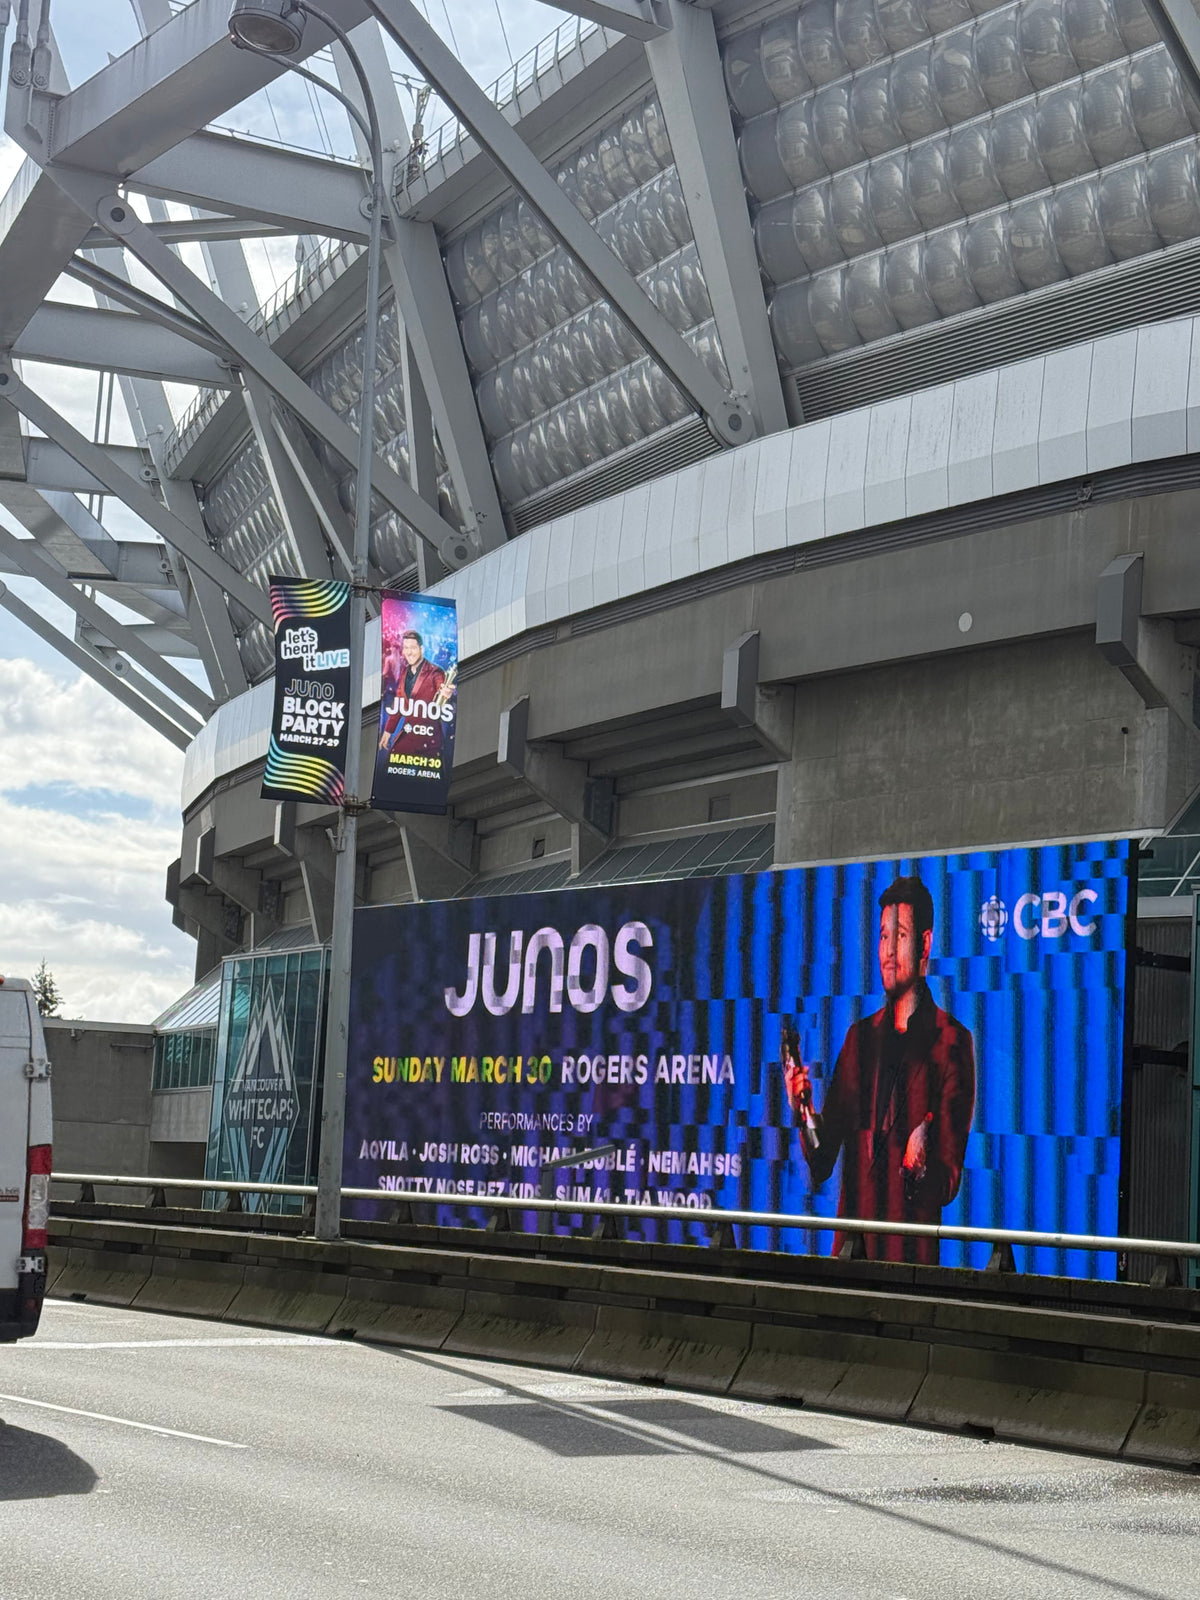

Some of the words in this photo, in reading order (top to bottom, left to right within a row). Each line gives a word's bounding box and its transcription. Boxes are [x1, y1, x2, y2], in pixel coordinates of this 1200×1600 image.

[288, 629, 316, 645] let's
[283, 643, 315, 657] hear
[306, 655, 316, 669] it
[317, 650, 348, 668] LIVE
[283, 696, 345, 719] BLOCK
[281, 714, 345, 737] PARTY
[412, 724, 434, 736] CBC
[280, 733, 312, 745] MARCH
[312, 737, 340, 748] 27-29
[389, 753, 428, 767] MARCH
[428, 758, 442, 769] 30
[387, 766, 416, 777] ROGERS
[417, 770, 441, 780] ARENA
[1013, 888, 1098, 940] CBC
[444, 920, 654, 1017] JUNOS
[372, 1056, 446, 1083] SUNDAY
[450, 1056, 523, 1083] MARCH
[526, 1055, 552, 1084] 30
[561, 1054, 649, 1085] ROGERS
[654, 1054, 735, 1085] ARENA
[228, 1097, 294, 1121] WHITECAPS
[479, 1112, 574, 1132] PERFORMANCES
[577, 1114, 594, 1132] BY
[249, 1126, 266, 1149] FC
[359, 1139, 409, 1161] AQYILA
[419, 1142, 458, 1164] JOSH
[460, 1143, 499, 1166] ROSS
[648, 1151, 742, 1177] NEMAHSIS
